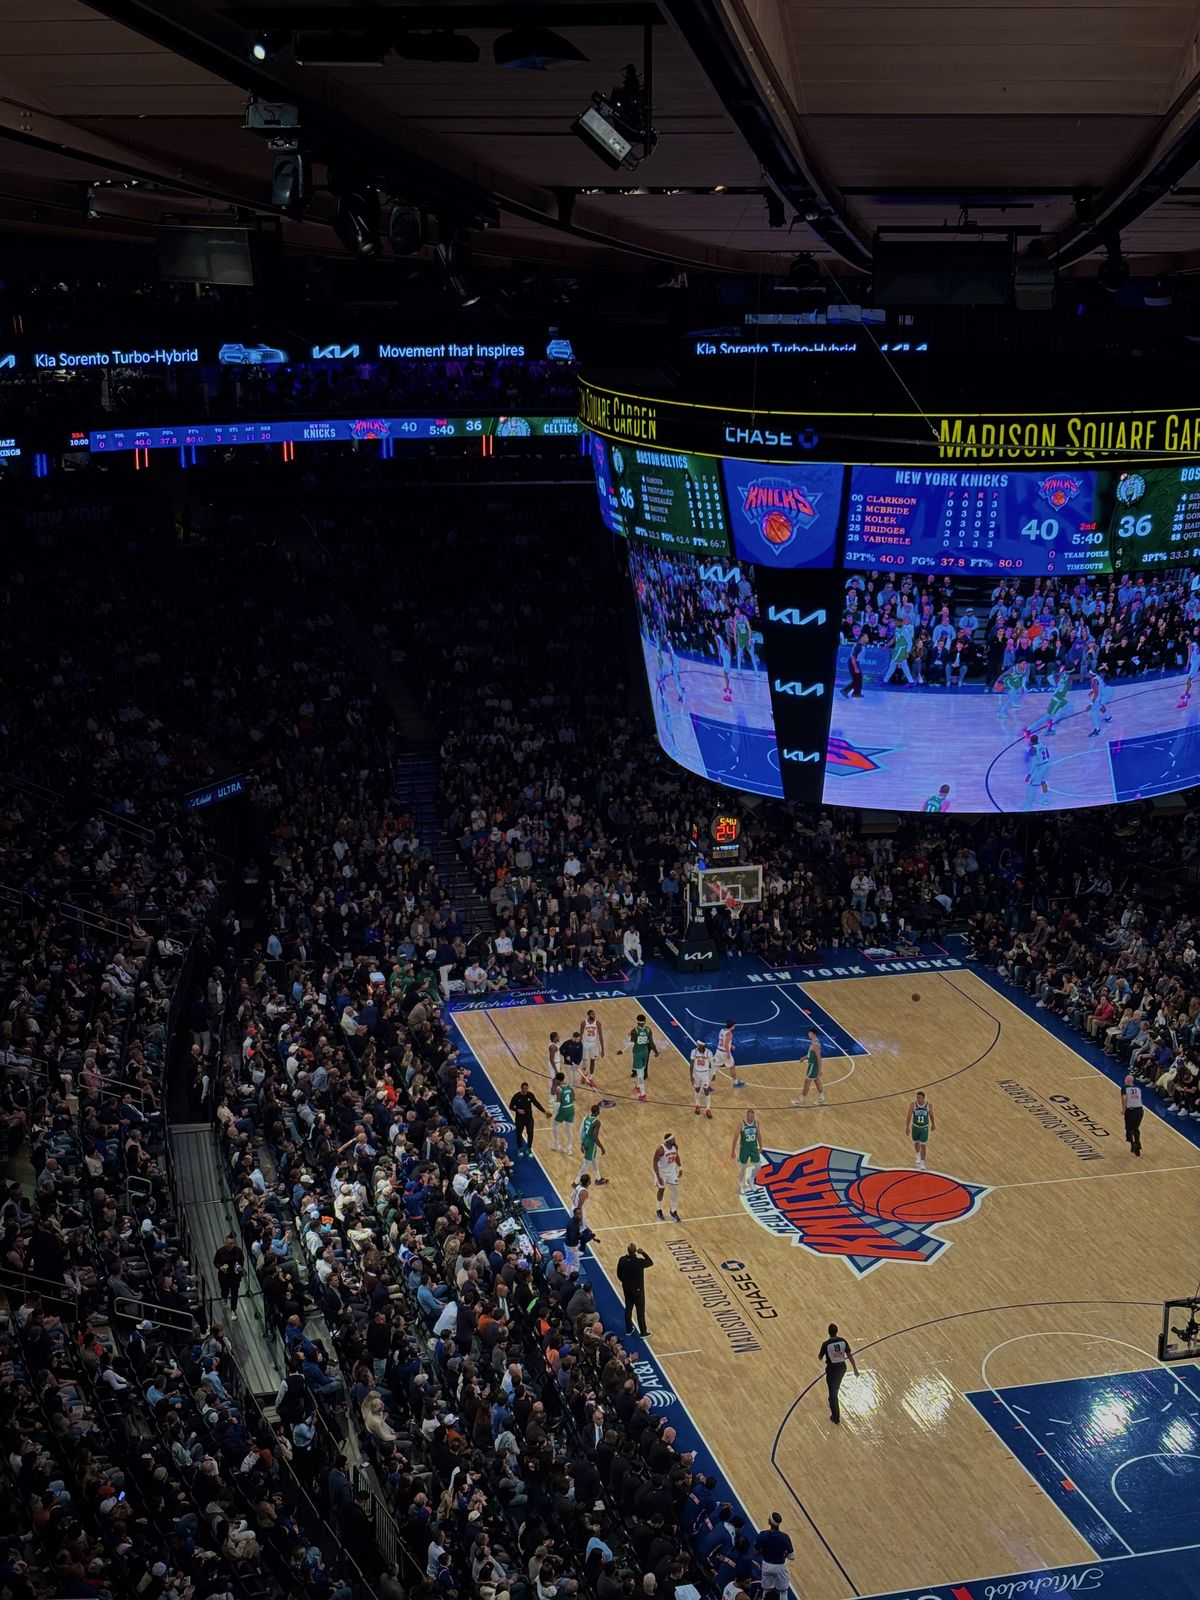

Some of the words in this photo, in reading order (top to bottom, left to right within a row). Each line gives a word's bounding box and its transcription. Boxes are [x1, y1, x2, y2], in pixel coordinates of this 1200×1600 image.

[380, 344, 445, 358] Movement
[448, 344, 473, 357] that
[477, 343, 524, 360] inspires
[697, 343, 716, 354] Kia
[720, 343, 768, 354] Sorento
[36, 354, 56, 367] Kia
[59, 353, 109, 366] Sorento
[112, 350, 198, 366] Turbo-Hybrid
[354, 420, 387, 433] KNICKS
[401, 422, 417, 432] 40
[466, 421, 482, 431] 36
[614, 397, 656, 440] GARDEN
[304, 428, 336, 438] KNICKS
[429, 425, 454, 435] 5:40
[544, 424, 578, 433] CELTICS
[726, 427, 792, 446] CHASE
[940, 420, 1056, 458] MADISON
[1066, 418, 1156, 459] SQUARE
[660, 453, 688, 469] CELTICS
[896, 470, 922, 485] NEW
[925, 472, 958, 486] YORK
[961, 474, 1008, 487] KNICKS
[620, 486, 634, 509] 36
[744, 485, 815, 515] KNICKS
[866, 495, 917, 505] CLARKSON
[865, 506, 910, 514] MCBRIDE
[864, 515, 897, 524] KOLEK
[1118, 514, 1152, 538] 36
[864, 526, 905, 535] BRIDGES
[1022, 519, 1059, 540] 40
[1072, 532, 1102, 544] 5:40
[710, 540, 726, 548] 66.7
[863, 535, 911, 545] YABUSELE
[846, 552, 876, 562] 3PT%
[880, 555, 904, 564] 40.0
[911, 556, 935, 566] FG%
[940, 558, 965, 567] 37.8
[970, 559, 993, 567] FT%
[999, 560, 1022, 568] 80.0
[1142, 552, 1167, 562] 3PT%
[1170, 550, 1189, 560] 33.3
[218, 781, 242, 797] ULTRA
[716, 826, 736, 840] 24
[746, 972, 793, 983] NEW
[802, 966, 866, 978] YORK
[875, 958, 963, 973] KNICKS
[452, 998, 528, 1010] Michelob
[551, 990, 627, 1001] ULTRA
[565, 1095, 571, 1103] 4
[995, 1079, 1037, 1103] GARDEN
[1024, 1103, 1067, 1130] SQUARE
[1060, 1105, 1110, 1137] CHASE
[584, 1125, 590, 1134] 7
[1053, 1130, 1105, 1160] MADISON
[745, 1187, 774, 1213] YORK
[754, 1146, 928, 1262] KNICKS
[757, 1215, 800, 1233] NEW
[665, 1238, 706, 1273] GARDEN
[687, 1272, 731, 1308] SQUARE
[732, 1272, 778, 1319] CHASE
[712, 1308, 762, 1354] MADISON
[630, 1361, 663, 1387] AT&T
[984, 1568, 1104, 1600] Michelob
